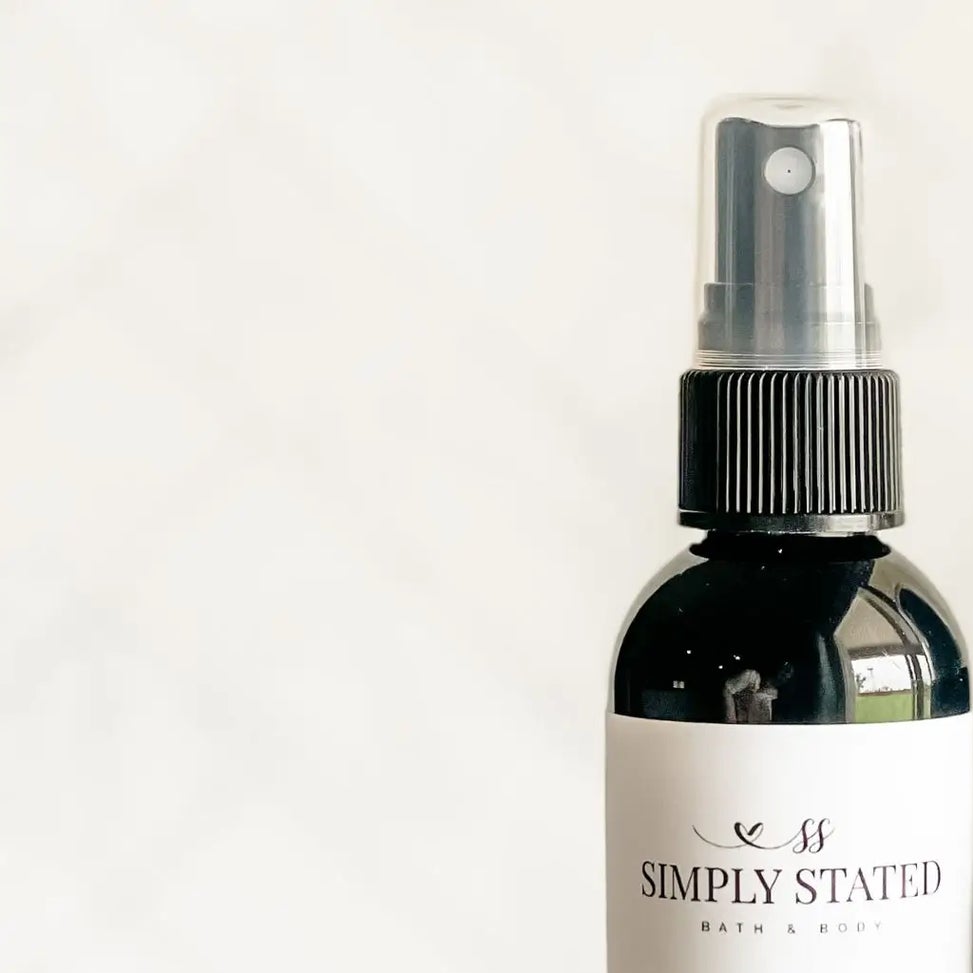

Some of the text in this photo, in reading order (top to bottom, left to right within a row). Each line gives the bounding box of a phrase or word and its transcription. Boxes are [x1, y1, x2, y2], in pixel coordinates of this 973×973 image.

[641, 860, 942, 904] SIMPLY STATED
[701, 921, 883, 934] BATH & BODY
